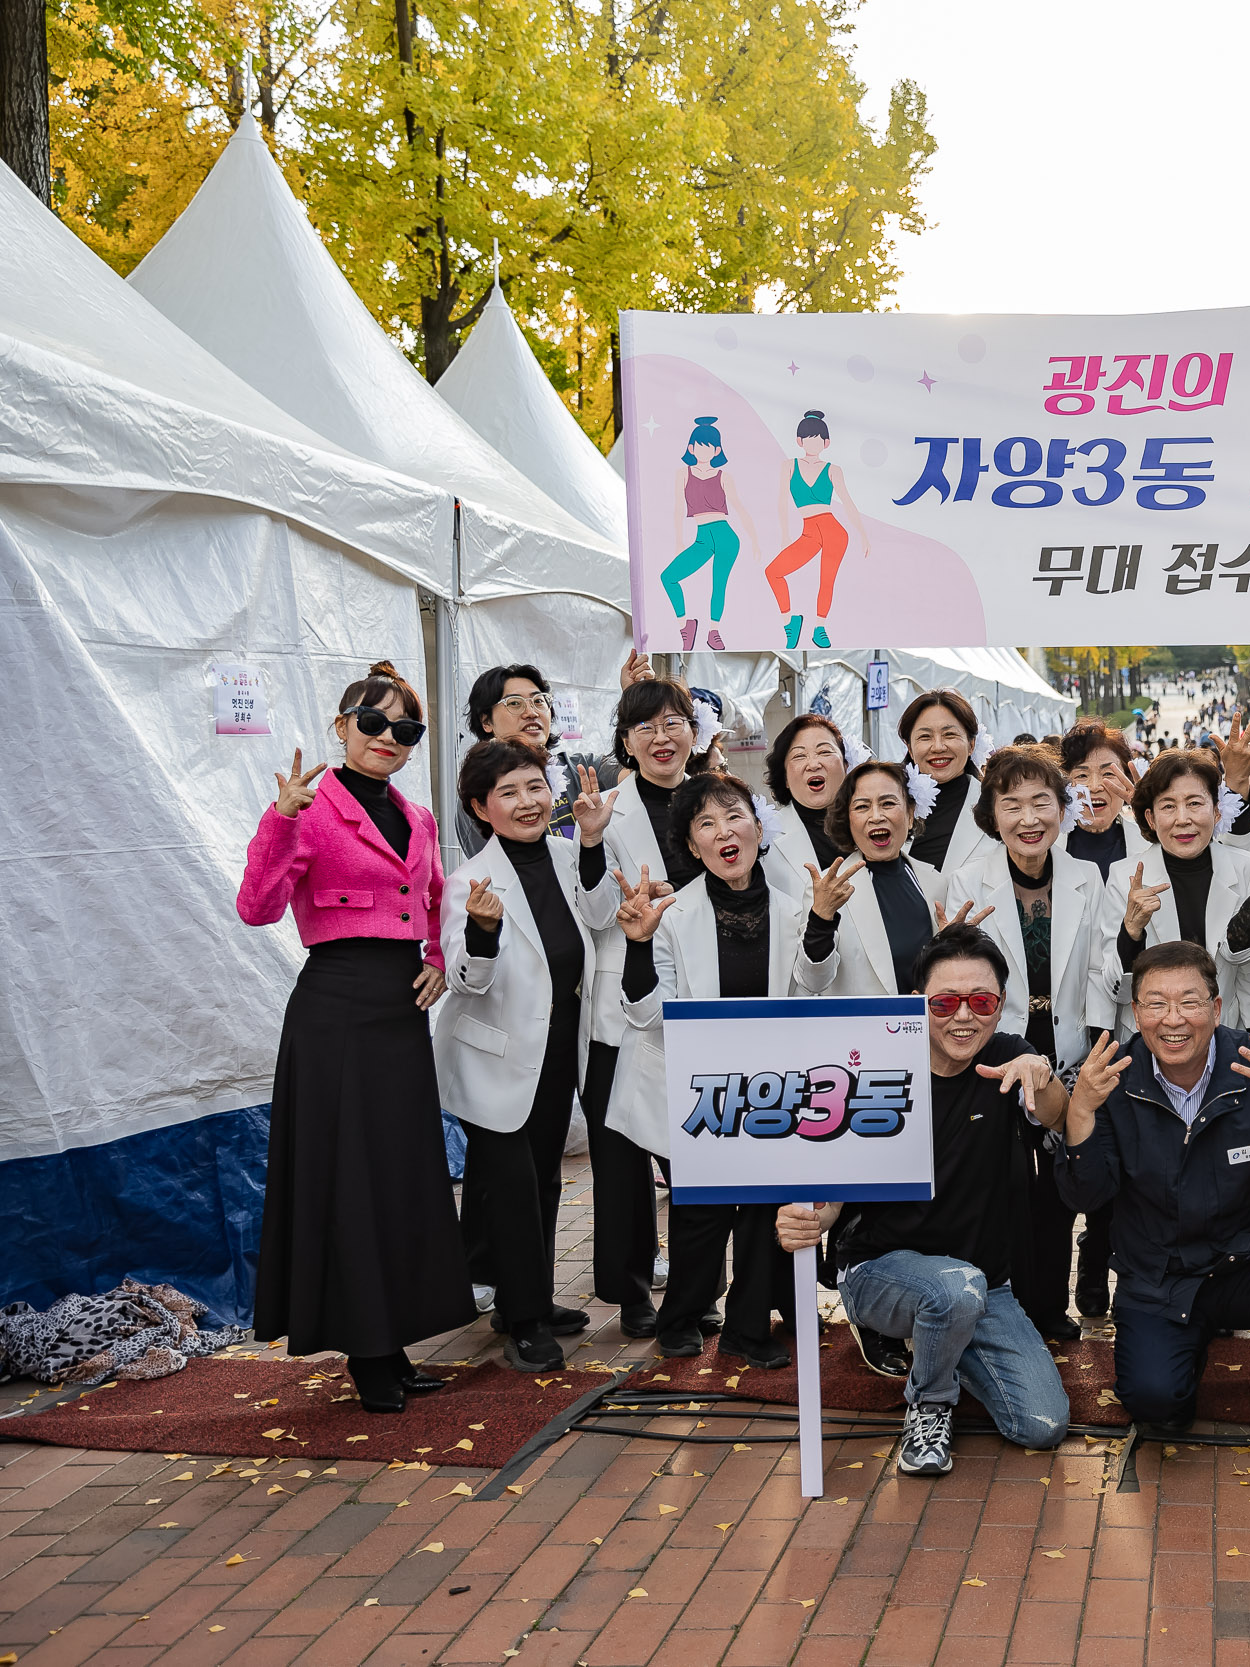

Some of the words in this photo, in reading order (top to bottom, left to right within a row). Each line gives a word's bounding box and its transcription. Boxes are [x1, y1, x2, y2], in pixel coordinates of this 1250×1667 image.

[1043, 352, 1234, 416] 광진의
[892, 436, 1215, 511] 자양3동
[1032, 544, 1143, 597] 무대
[681, 1064, 914, 1142] 자양3동
